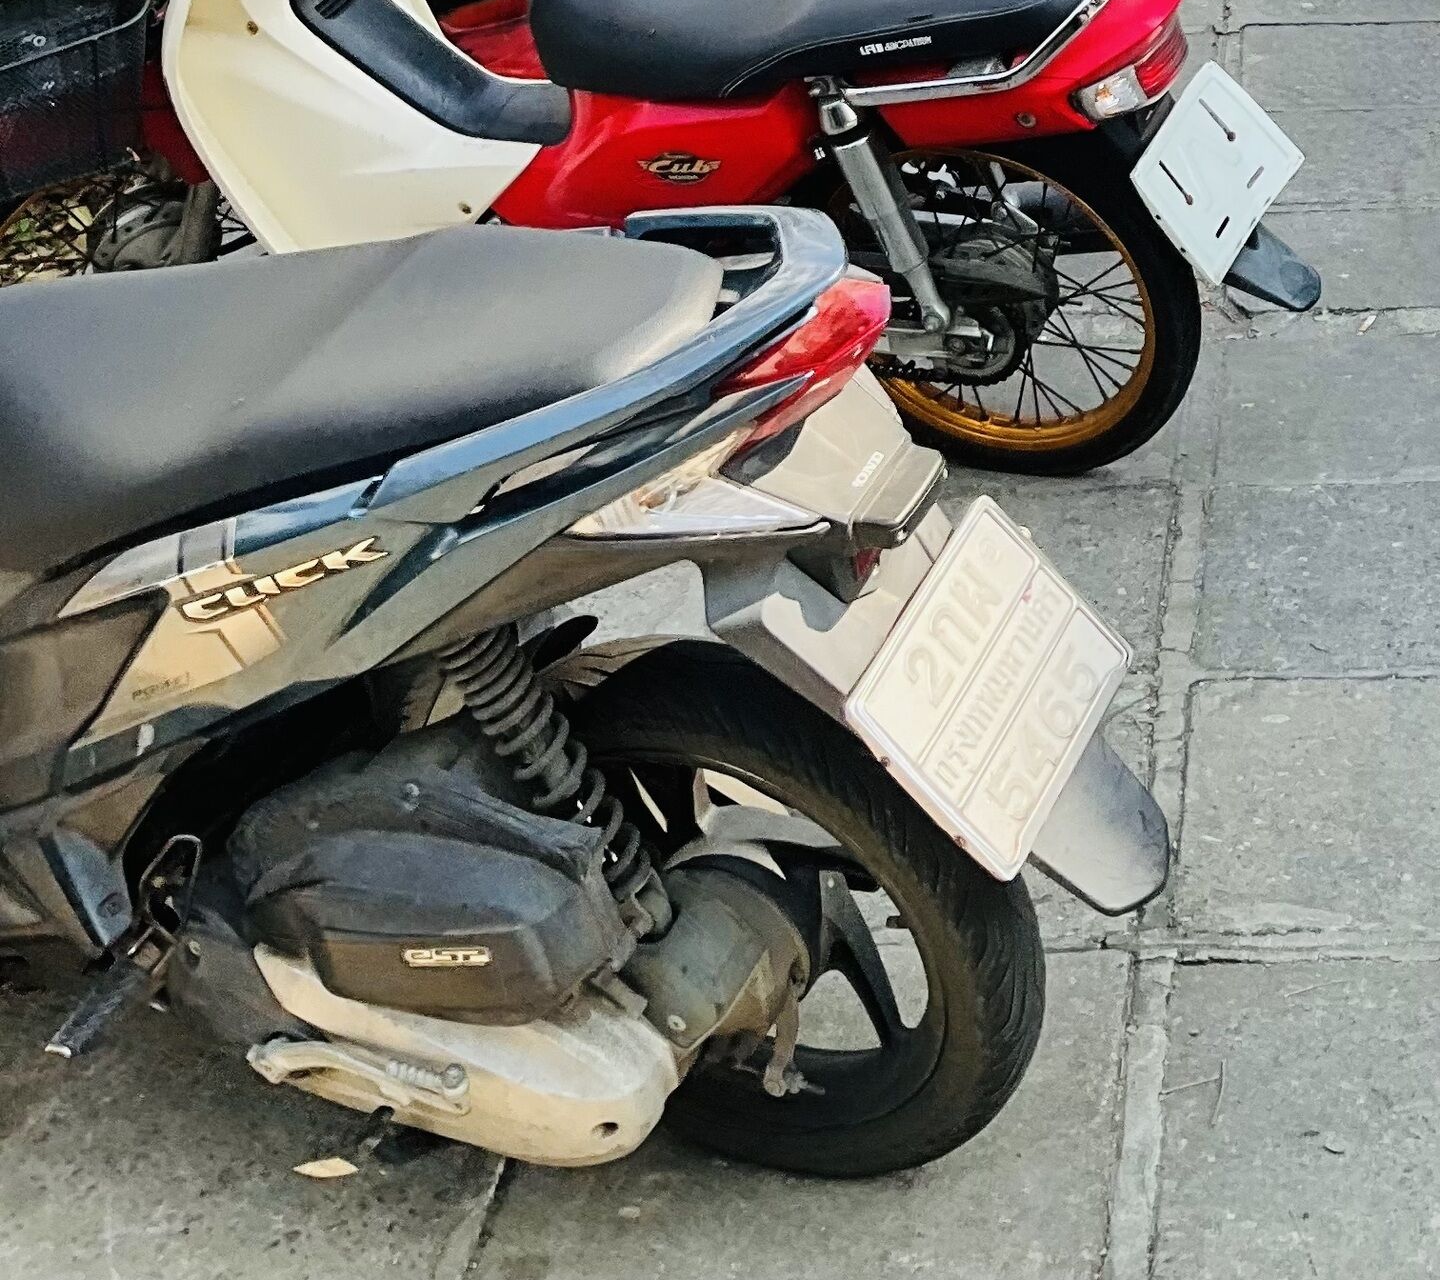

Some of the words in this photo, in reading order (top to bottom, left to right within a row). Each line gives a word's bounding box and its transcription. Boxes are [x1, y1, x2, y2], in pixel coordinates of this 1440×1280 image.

[648, 159, 711, 174] Cub
[181, 535, 390, 622] CLICK
[984, 640, 1099, 821] 5465
